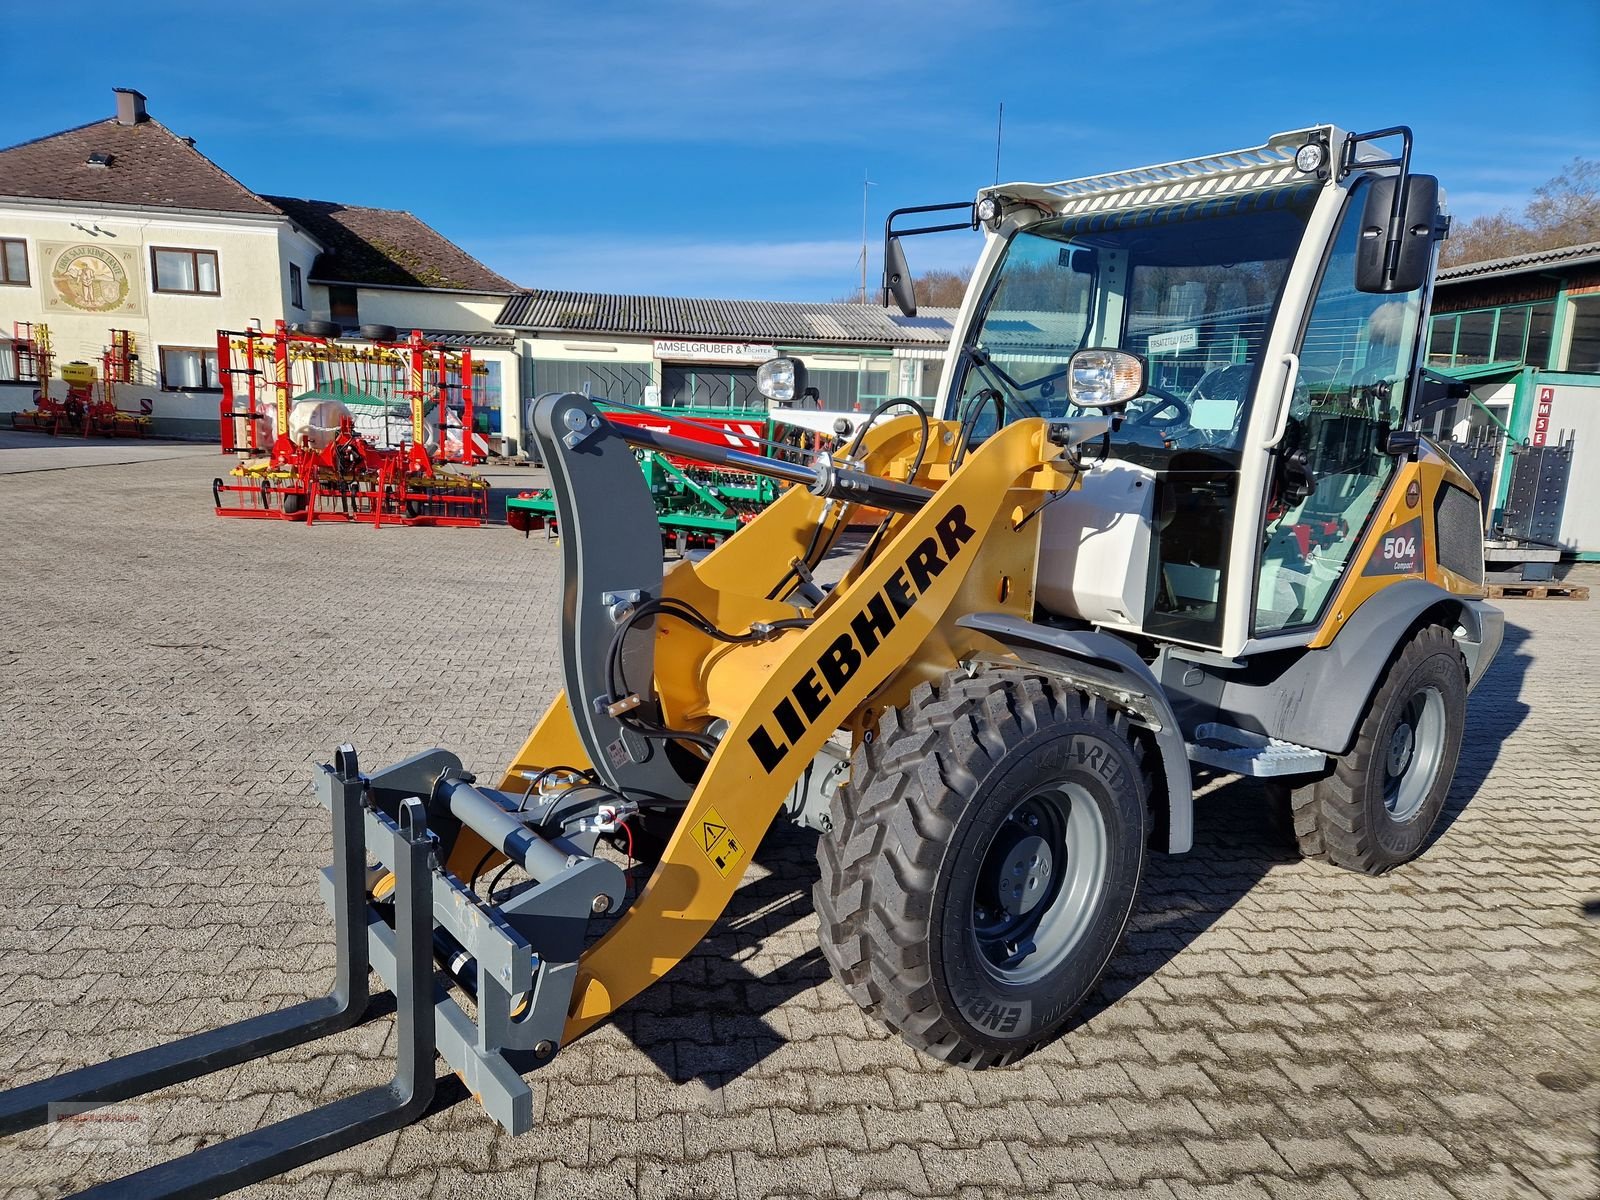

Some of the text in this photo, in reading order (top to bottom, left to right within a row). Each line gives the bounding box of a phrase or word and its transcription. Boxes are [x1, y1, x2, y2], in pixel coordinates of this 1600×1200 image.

[70, 247, 86, 258] SAAT
[87, 247, 106, 258] KEINE
[105, 256, 122, 275] ERNTE
[656, 342, 733, 354] AMSELGRUBER
[735, 345, 742, 355] &
[1383, 536, 1416, 560] 504
[1393, 562, 1414, 571] Compact
[747, 504, 976, 774] LIEBHERR
